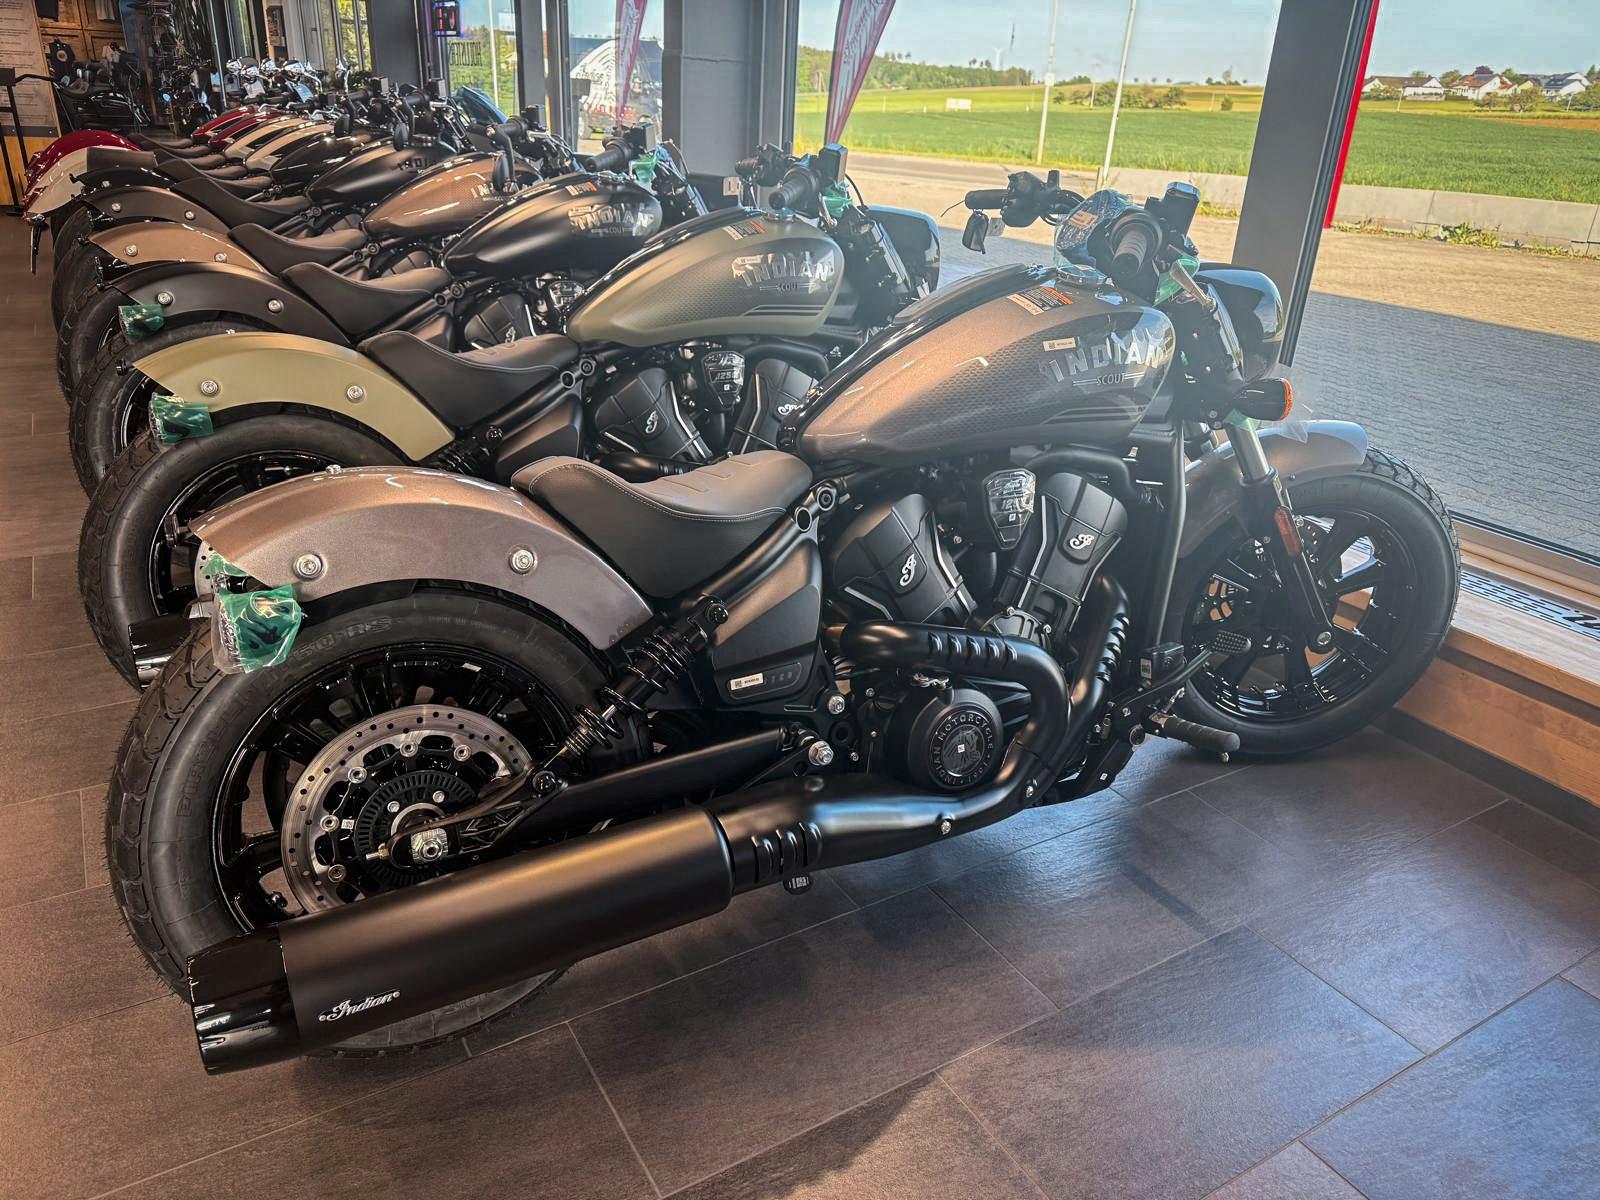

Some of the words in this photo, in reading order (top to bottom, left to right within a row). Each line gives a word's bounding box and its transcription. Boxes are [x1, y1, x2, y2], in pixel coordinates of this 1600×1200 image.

[741, 260, 829, 287] INDIAN
[1048, 341, 1161, 382] INDIAN
[1096, 372, 1126, 386] SCOUT
[937, 713, 993, 749] MOTORCYCLE
[326, 993, 393, 1021] Indian
